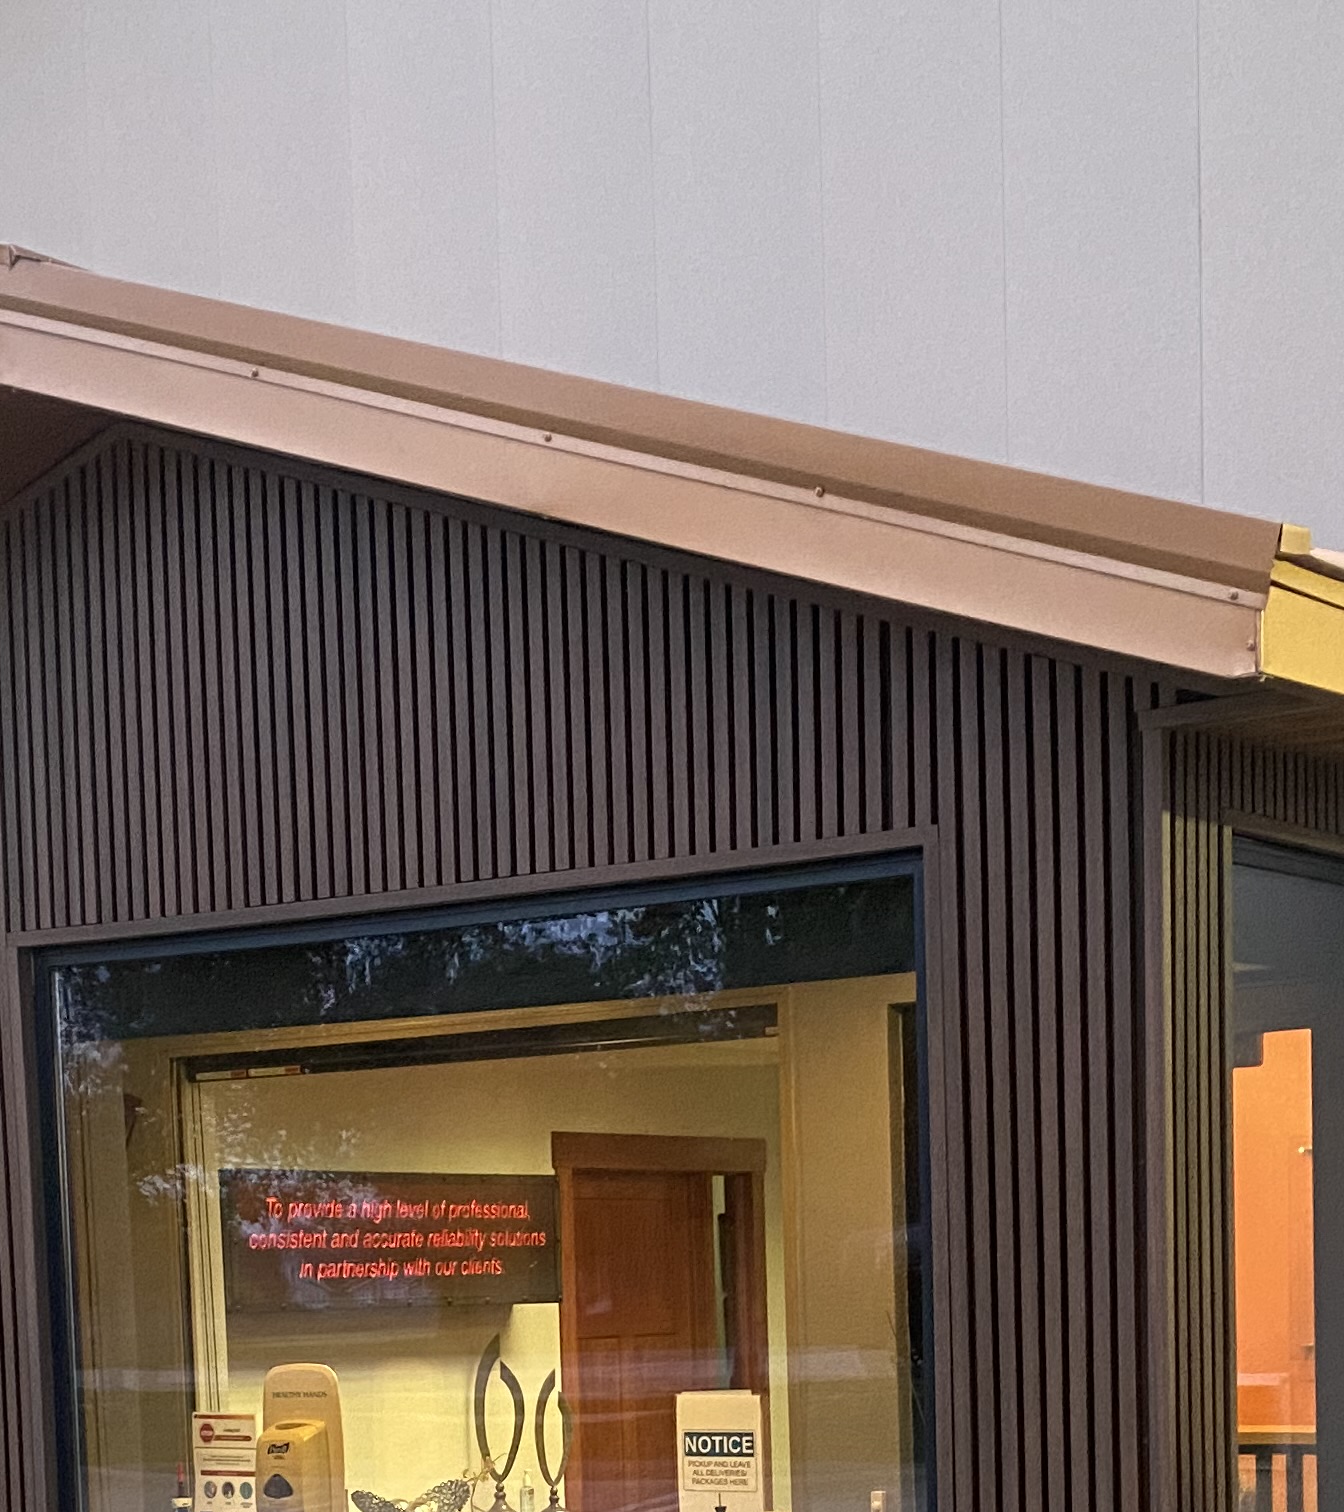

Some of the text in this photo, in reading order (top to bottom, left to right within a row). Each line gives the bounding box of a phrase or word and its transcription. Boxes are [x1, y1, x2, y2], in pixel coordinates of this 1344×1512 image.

[266, 1196, 283, 1219] To
[287, 1200, 343, 1223] provide
[347, 1202, 357, 1219] a
[361, 1200, 393, 1225] high
[396, 1199, 430, 1221] level
[432, 1199, 446, 1220] of
[248, 1228, 546, 1252] consistent and accurate reliability solutions
[298, 1259, 314, 1280] in
[316, 1257, 400, 1282] partnership
[402, 1256, 431, 1278] with
[435, 1260, 457, 1277] our
[685, 1435, 754, 1454] NOTICE
